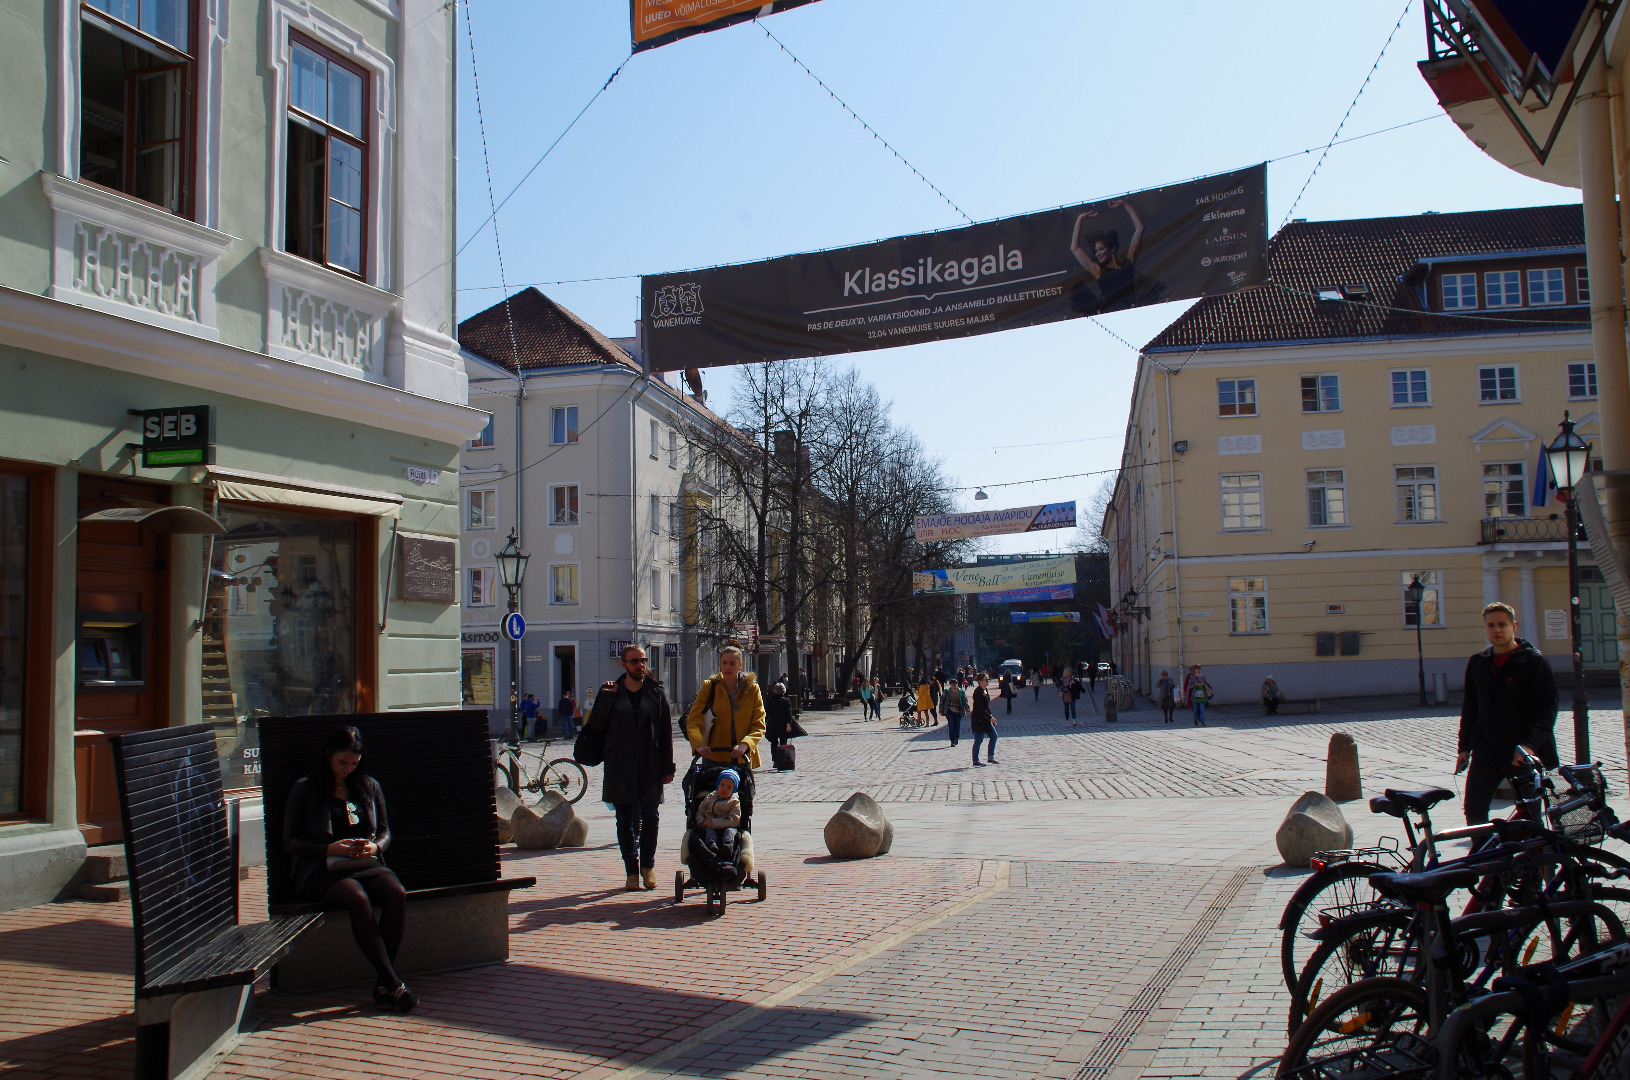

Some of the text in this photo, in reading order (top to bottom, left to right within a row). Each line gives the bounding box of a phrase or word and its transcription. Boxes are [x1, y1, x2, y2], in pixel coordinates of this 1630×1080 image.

[645, 10, 672, 24] UUED
[1211, 208, 1246, 220] kinema
[1205, 231, 1247, 244] LARSEN
[843, 244, 1024, 297] Klassikagala
[807, 322, 822, 332] PAS
[823, 321, 834, 331] DE
[868, 307, 931, 324] VARIATSIOONID
[932, 305, 944, 315] JA
[945, 297, 996, 313] ANSAMBLID
[996, 286, 1063, 304] BALLETTIDEST
[653, 316, 702, 329] VANEMUINE
[867, 313, 996, 339] 22.04 VANEMUISE SUURES MAJAS
[145, 414, 197, 438] SEB
[916, 509, 1033, 529] EMAJÕE HOOAJA AVAPIDU
[952, 569, 979, 582] Vene
[977, 574, 1002, 587] Ball
[1021, 569, 1065, 582] Vanemuise
